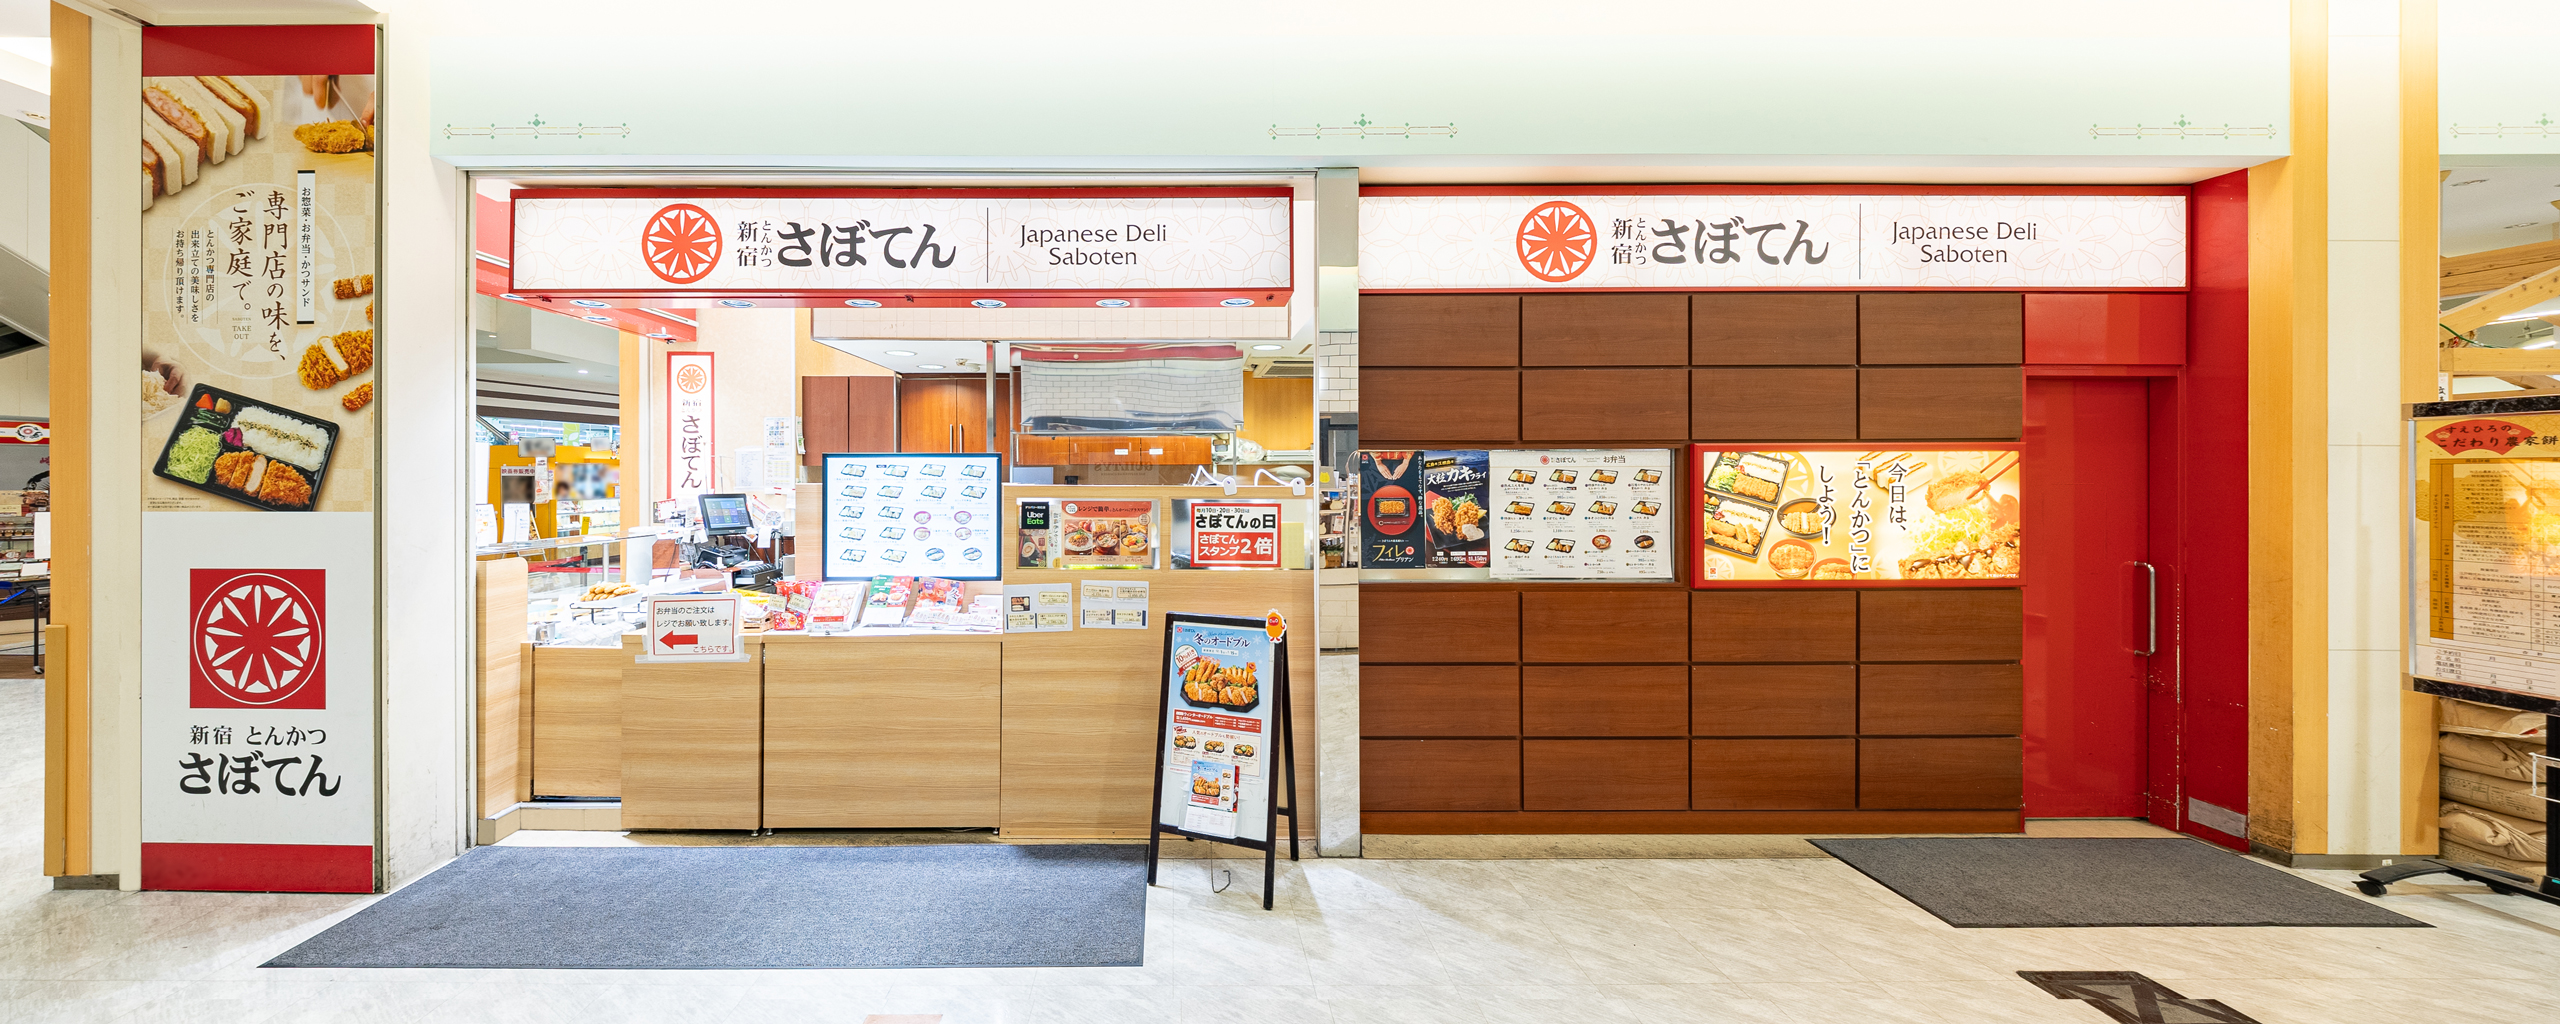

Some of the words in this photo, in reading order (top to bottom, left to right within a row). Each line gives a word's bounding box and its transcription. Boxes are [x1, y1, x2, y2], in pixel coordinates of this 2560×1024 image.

[761, 220, 772, 268] とんかつ
[776, 219, 956, 269] さぼてん
[1020, 224, 1118, 248] Japanese
[1126, 224, 1166, 242] Deli
[1635, 217, 1647, 265] とんかつ
[1651, 215, 1829, 265] さぼてん
[1892, 221, 1989, 245] Japanese
[1997, 221, 2037, 240] Deli
[226, 190, 255, 310] ご家庭で。
[301, 187, 311, 307] お惣菜・お弁当・かつサンド
[1049, 247, 1137, 265] Saboten
[1920, 244, 2008, 263] Saboten
[175, 230, 184, 318] お持ち帰り頂けます。
[190, 230, 200, 322] 出来立ての美味しさを
[205, 230, 215, 301] とんかつ専門店の
[262, 190, 290, 360] 専門店の味を、
[2445, 425, 2512, 434] すえひろの
[681, 414, 703, 489] さぼてん
[1603, 455, 1626, 464] お弁当
[1427, 465, 1487, 486] 大粒カキフライ
[1888, 462, 1908, 532] 今日は、
[1196, 514, 1276, 529] さぼてんの日
[1850, 461, 1871, 573] 「とんかつ」に
[1199, 534, 1240, 545] さぼてん
[1199, 546, 1240, 556] スタンプ
[1372, 544, 1405, 562] フィレ
[656, 606, 715, 615] お弁当のご注文は
[656, 618, 732, 627] レジでお願い致します。
[1193, 632, 1251, 648] 冬のオードブル
[189, 724, 233, 745] 新宿
[246, 725, 327, 745] とんかつ
[179, 750, 341, 797] さぼてん
